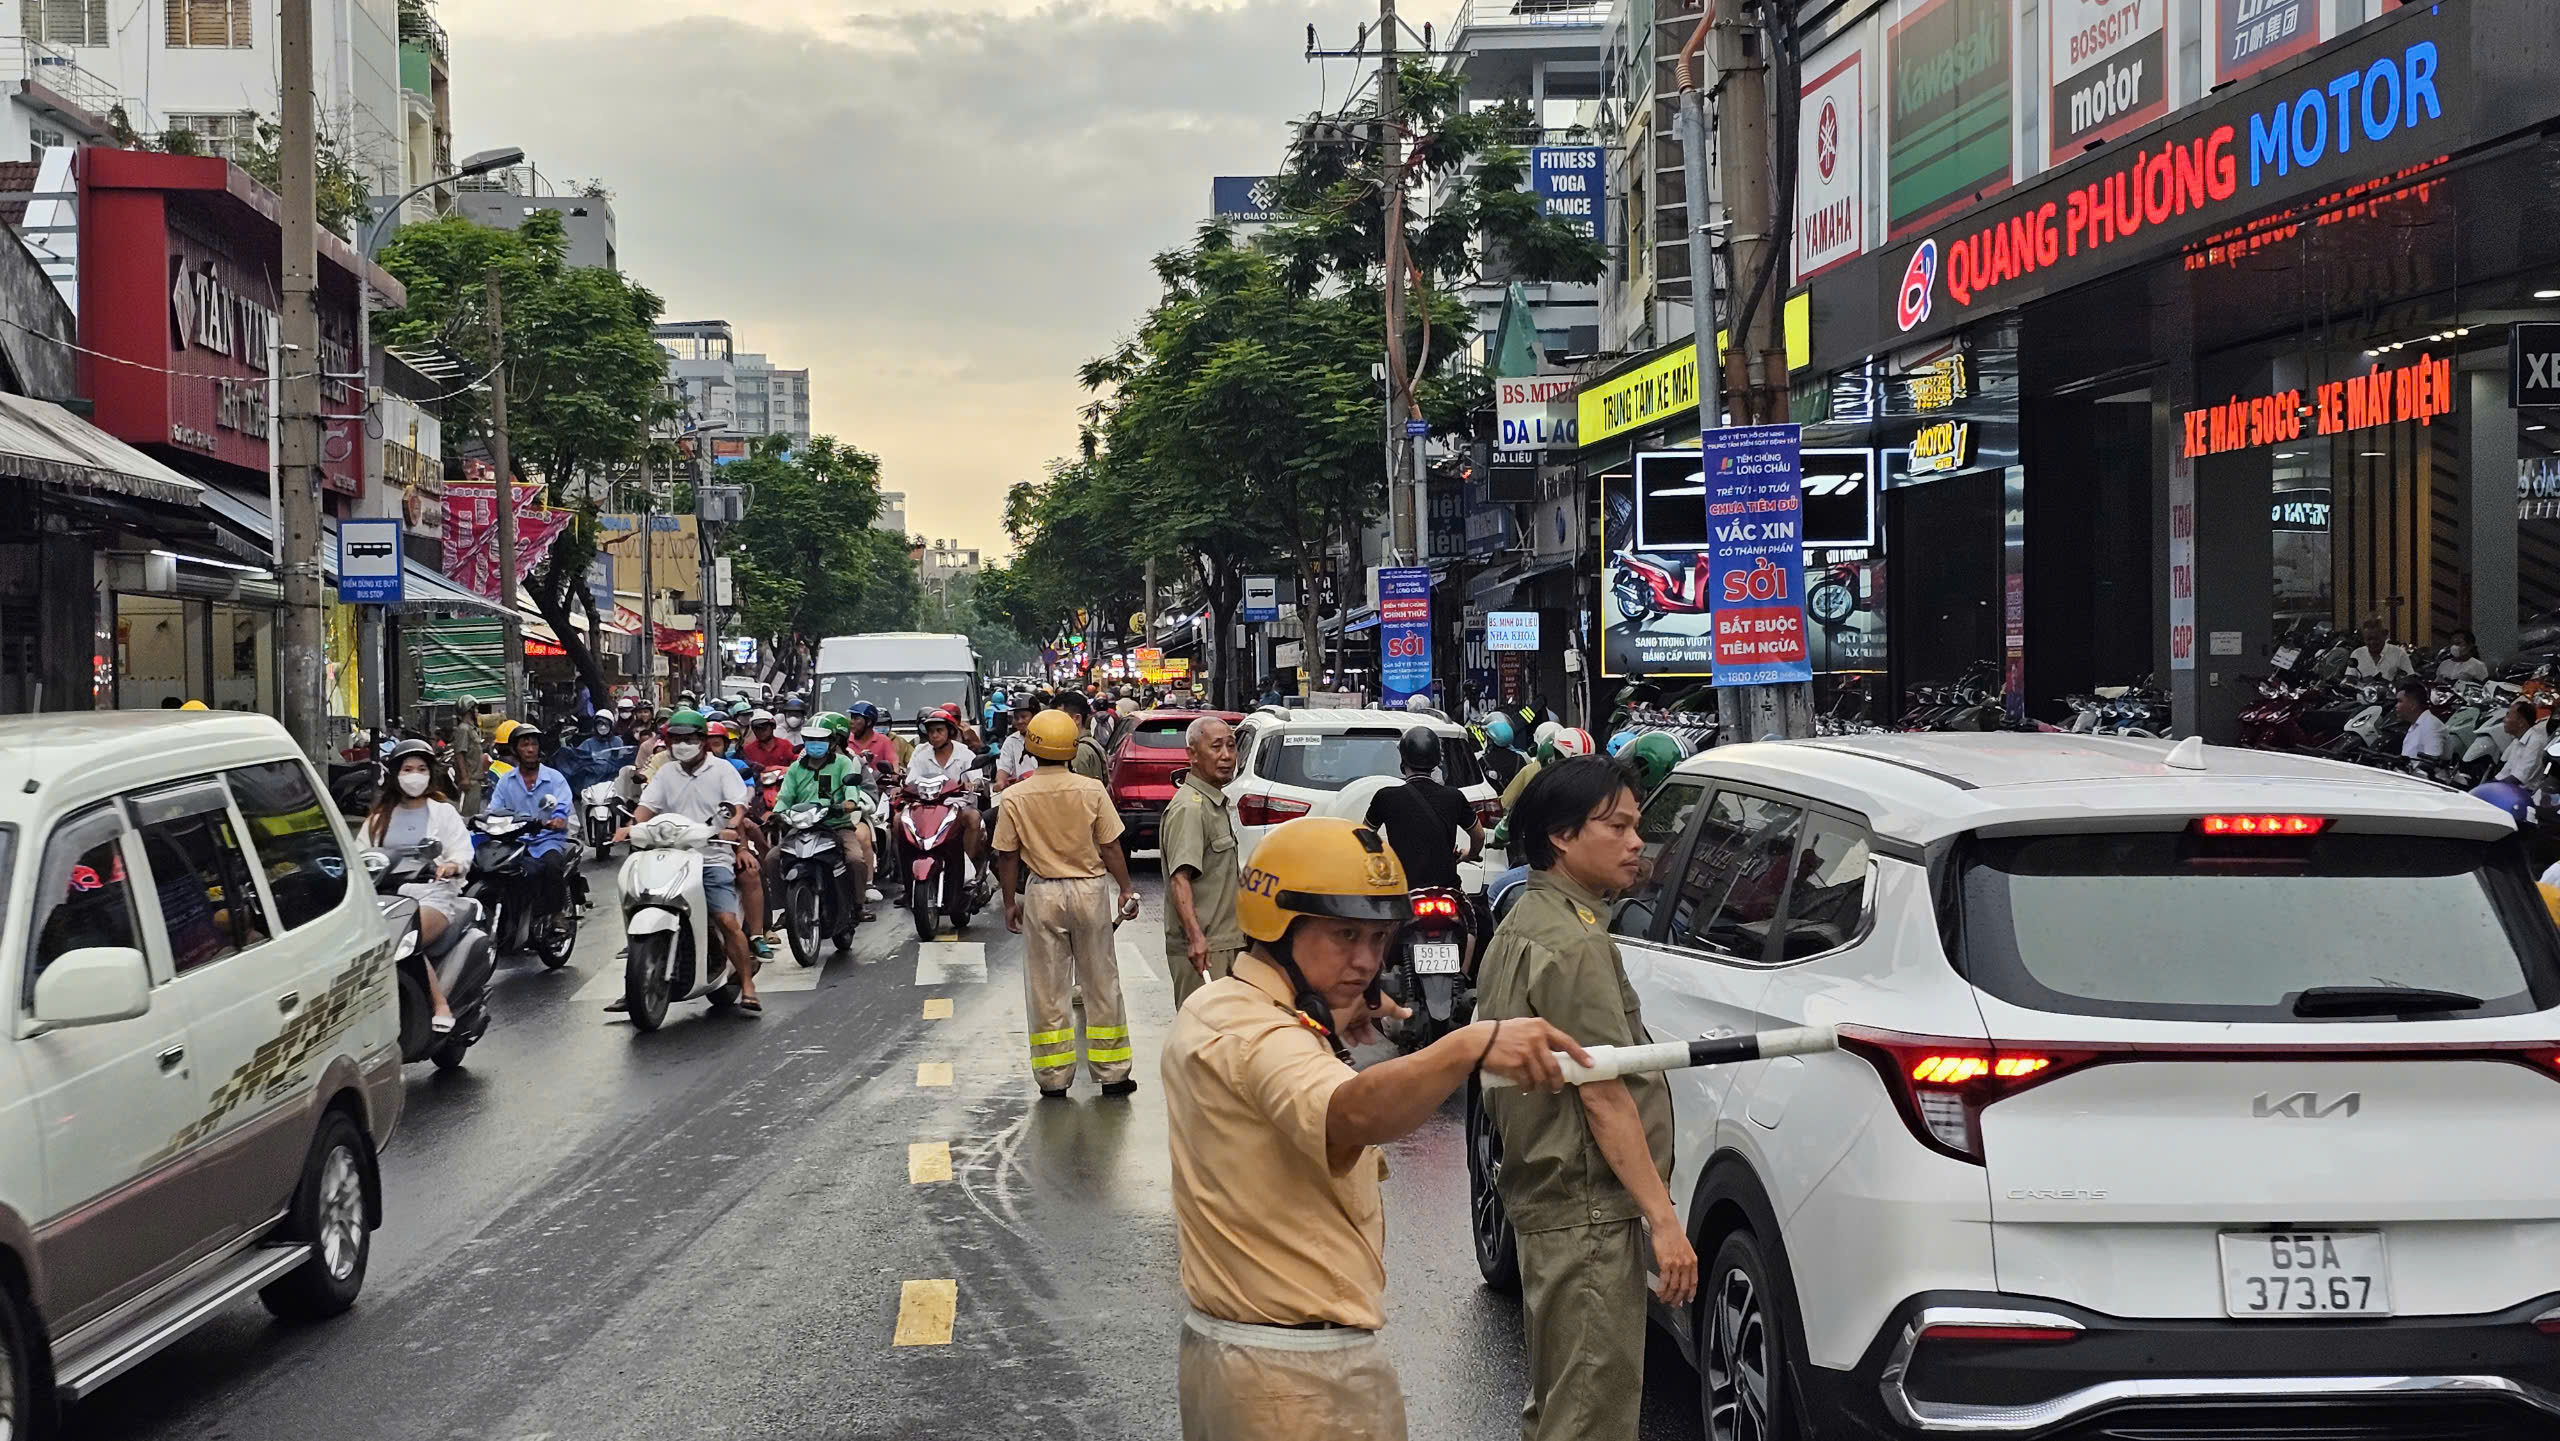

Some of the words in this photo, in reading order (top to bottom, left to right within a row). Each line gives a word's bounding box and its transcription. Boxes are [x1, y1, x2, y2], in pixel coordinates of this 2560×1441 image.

[2070, 0, 2141, 64] BOSSCITY
[2232, 5, 2299, 60] 力帆集团
[1897, 9, 2000, 116] Kawasaki
[2071, 59, 2142, 134] motor
[1540, 151, 1596, 169] FITNESS
[1551, 175, 1586, 192] YOGA
[1947, 201, 2058, 305] QUANG
[2066, 125, 2236, 256] PHƯƠNG
[2250, 41, 2442, 187] MOTOR
[1546, 198, 1591, 215] DANCE
[1805, 196, 1852, 259] YAMAHA
[196, 262, 235, 358] TÂN
[1603, 388, 1632, 432] TRUNG
[1634, 374, 1654, 420] TÂM
[1656, 372, 1669, 412] XE
[1672, 355, 1695, 406] MÁY
[2183, 409, 2207, 459] XE
[2210, 394, 2249, 454] MÁY
[2251, 389, 2300, 447] 50CC
[2317, 382, 2344, 436] XE
[2347, 363, 2393, 431] MÁY
[2396, 352, 2450, 427] ĐIỆN
[1503, 419, 1530, 444] DA
[1915, 423, 1953, 458] MOTOR
[1493, 452, 1506, 463] DA
[1736, 454, 1753, 463] TIÊM
[1736, 464, 1762, 475] LONG
[1764, 462, 1791, 473] CHÂU
[1759, 485, 1767, 494] 10
[1709, 501, 1746, 516] CHƯA
[1747, 498, 1777, 513] TIÊM
[1778, 495, 1799, 511] ĐỦ
[1715, 517, 1757, 542] VẮC
[1761, 521, 1794, 540] XIN
[1719, 545, 1733, 557] CÓ
[1735, 543, 1767, 556] THÀNH
[1723, 557, 1788, 602] SỞI
[370, 590, 384, 598] STOP
[1490, 631, 1509, 641] NHA
[1511, 631, 1536, 641] KHOA
[1720, 616, 1751, 634] BẮT
[1755, 615, 1798, 634] BUỘC
[1388, 630, 1425, 657] SỞI
[1635, 637, 1658, 648] SANG
[1721, 640, 1755, 656] TIÊM
[1758, 638, 1799, 654] NGỪA
[1727, 672, 1751, 682] 1800
[1753, 670, 1778, 681] 6928
[2253, 1091, 2361, 1118] KIA
[2006, 1188, 2110, 1200] CARENS
[2270, 1235, 2341, 1270] 65A
[2246, 1275, 2372, 1311] 373.67
